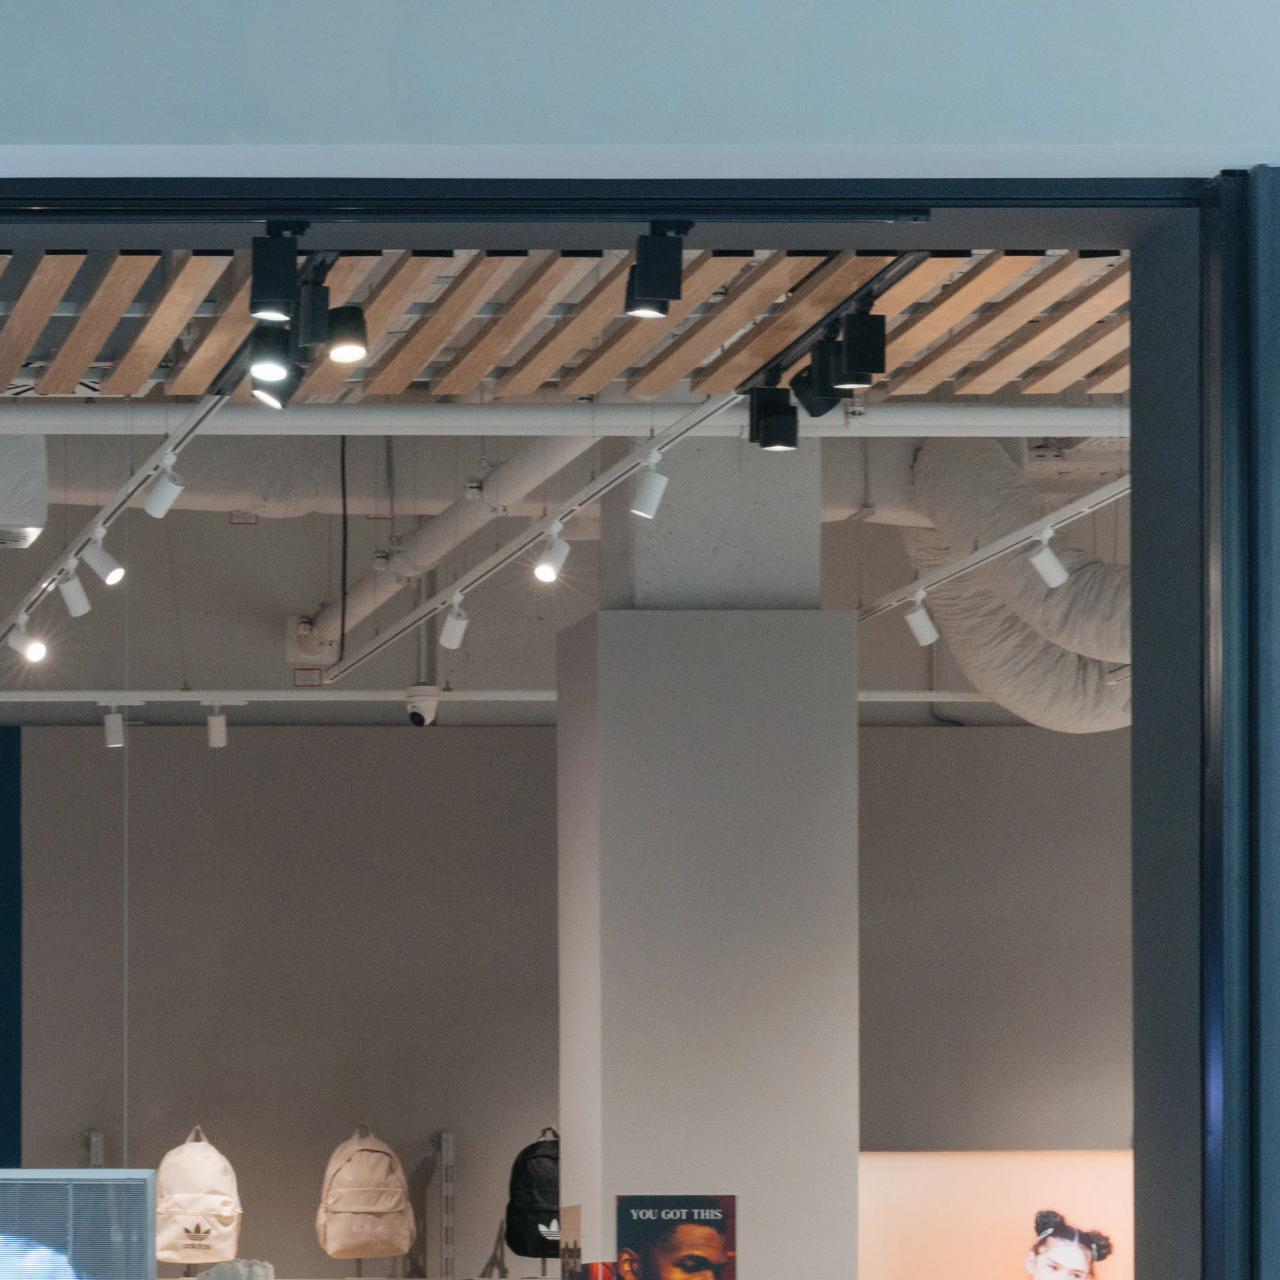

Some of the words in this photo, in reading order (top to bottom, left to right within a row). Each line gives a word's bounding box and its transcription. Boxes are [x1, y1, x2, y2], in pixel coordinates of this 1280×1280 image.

[630, 1208, 658, 1220] YOU
[661, 1208, 689, 1220] GOT
[691, 1208, 723, 1220] THIS
